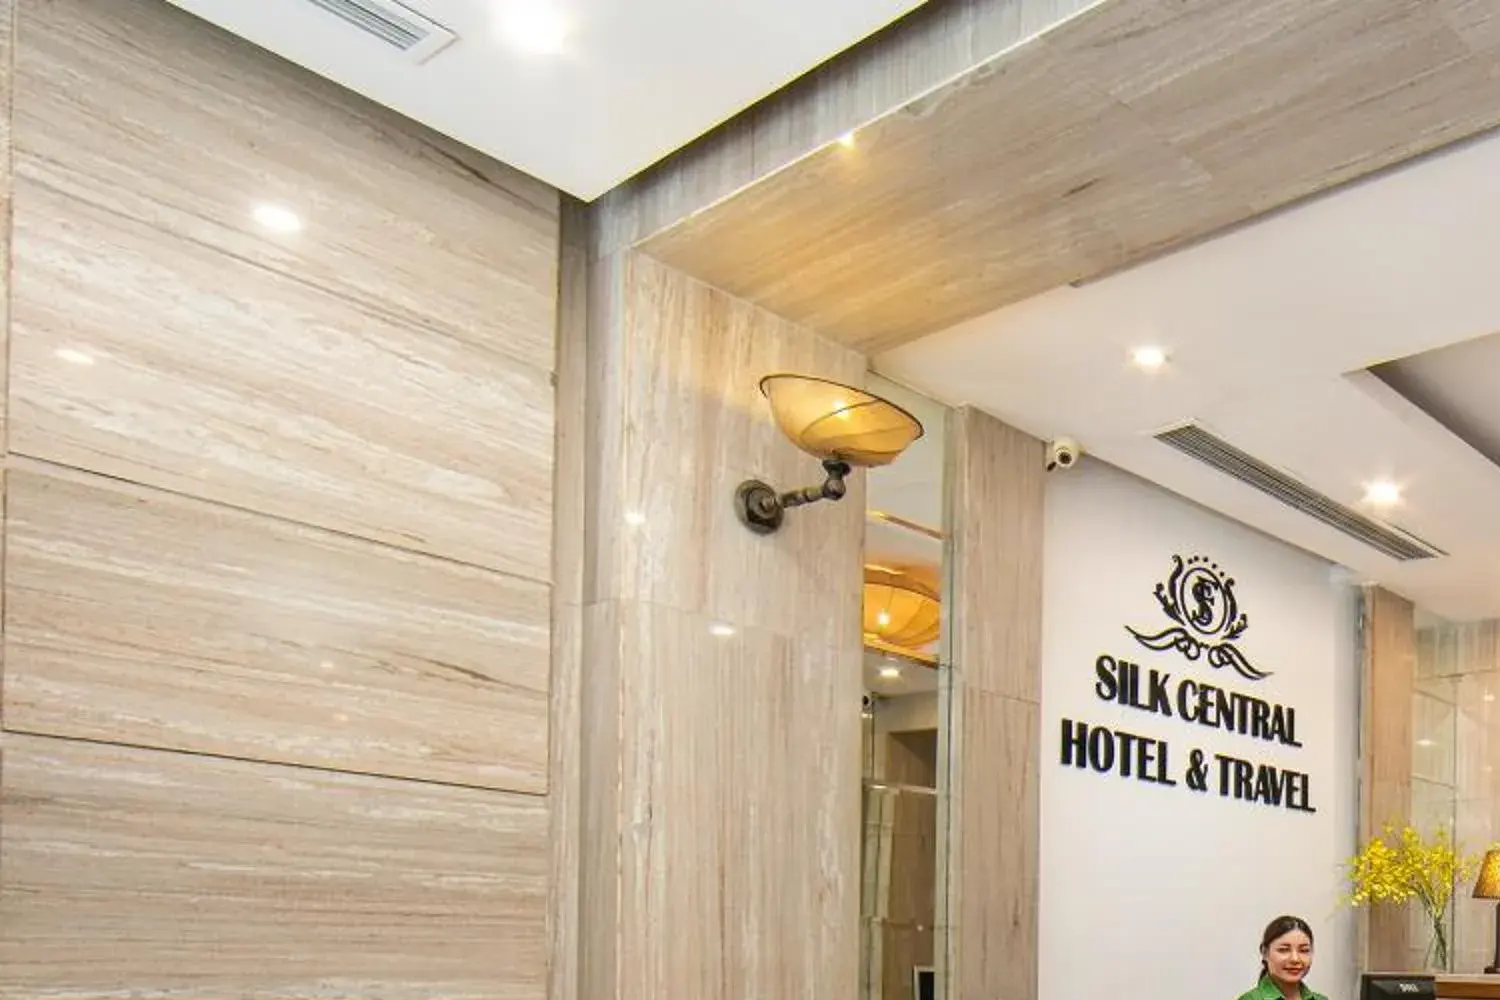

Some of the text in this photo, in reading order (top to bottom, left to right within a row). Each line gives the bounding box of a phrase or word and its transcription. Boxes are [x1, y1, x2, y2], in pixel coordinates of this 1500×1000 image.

[1095, 655, 1303, 748] SILK CENTRAL
[1061, 718, 1317, 813] HOTEL & TRAVEL
